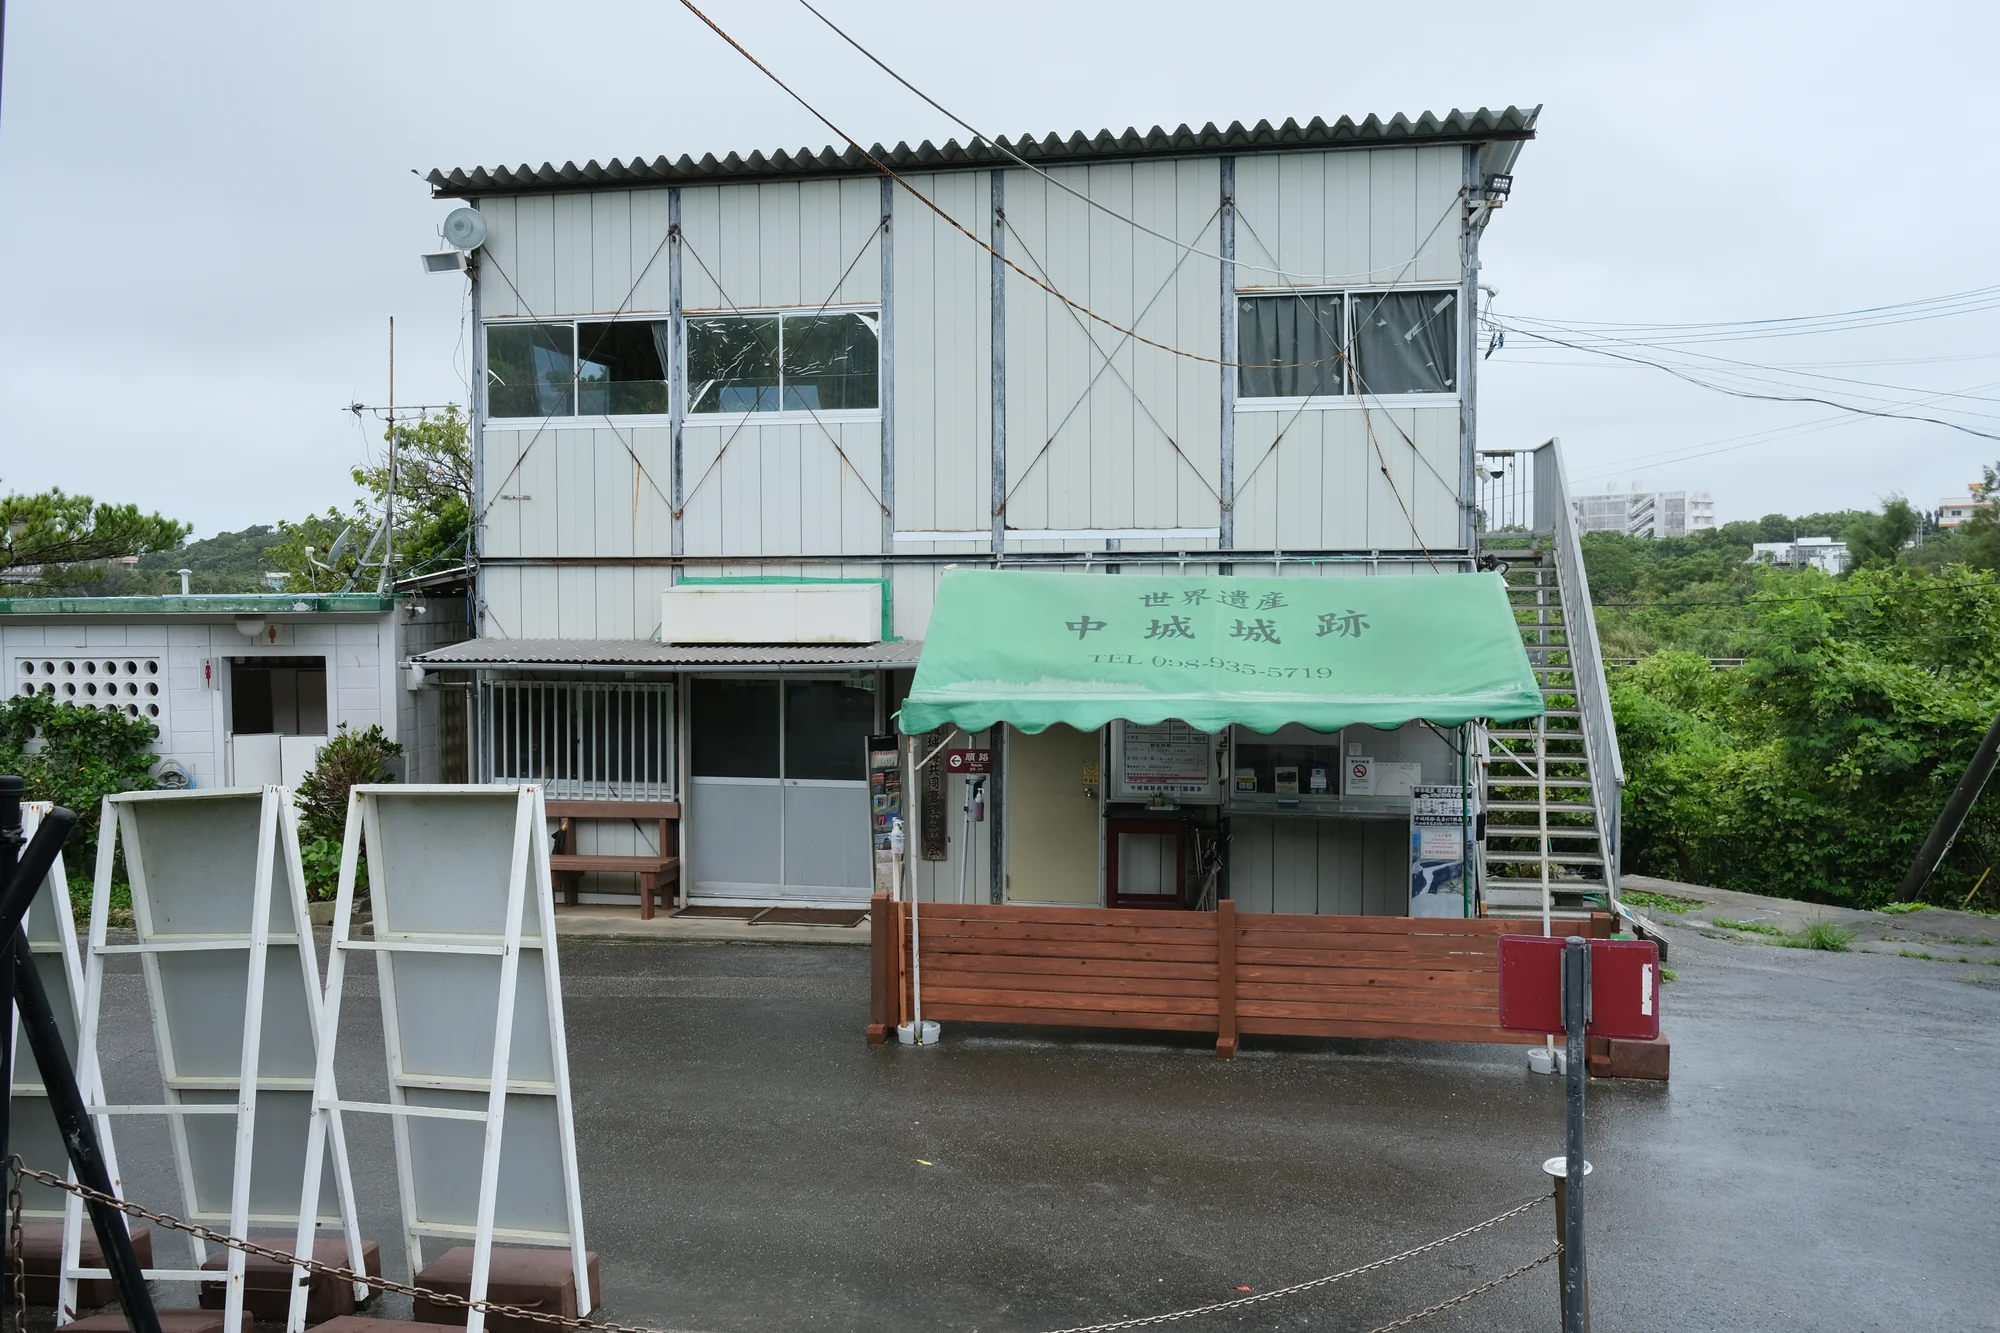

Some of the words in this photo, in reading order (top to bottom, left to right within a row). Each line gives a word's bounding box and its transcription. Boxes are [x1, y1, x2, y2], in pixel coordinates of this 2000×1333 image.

[1139, 588, 1289, 611] 世界遺産
[1064, 610, 1371, 645] 中城城跡
[1088, 653, 1143, 665] TEL
[1151, 656, 1333, 680] 098-935-5719
[965, 752, 989, 762] 順路
